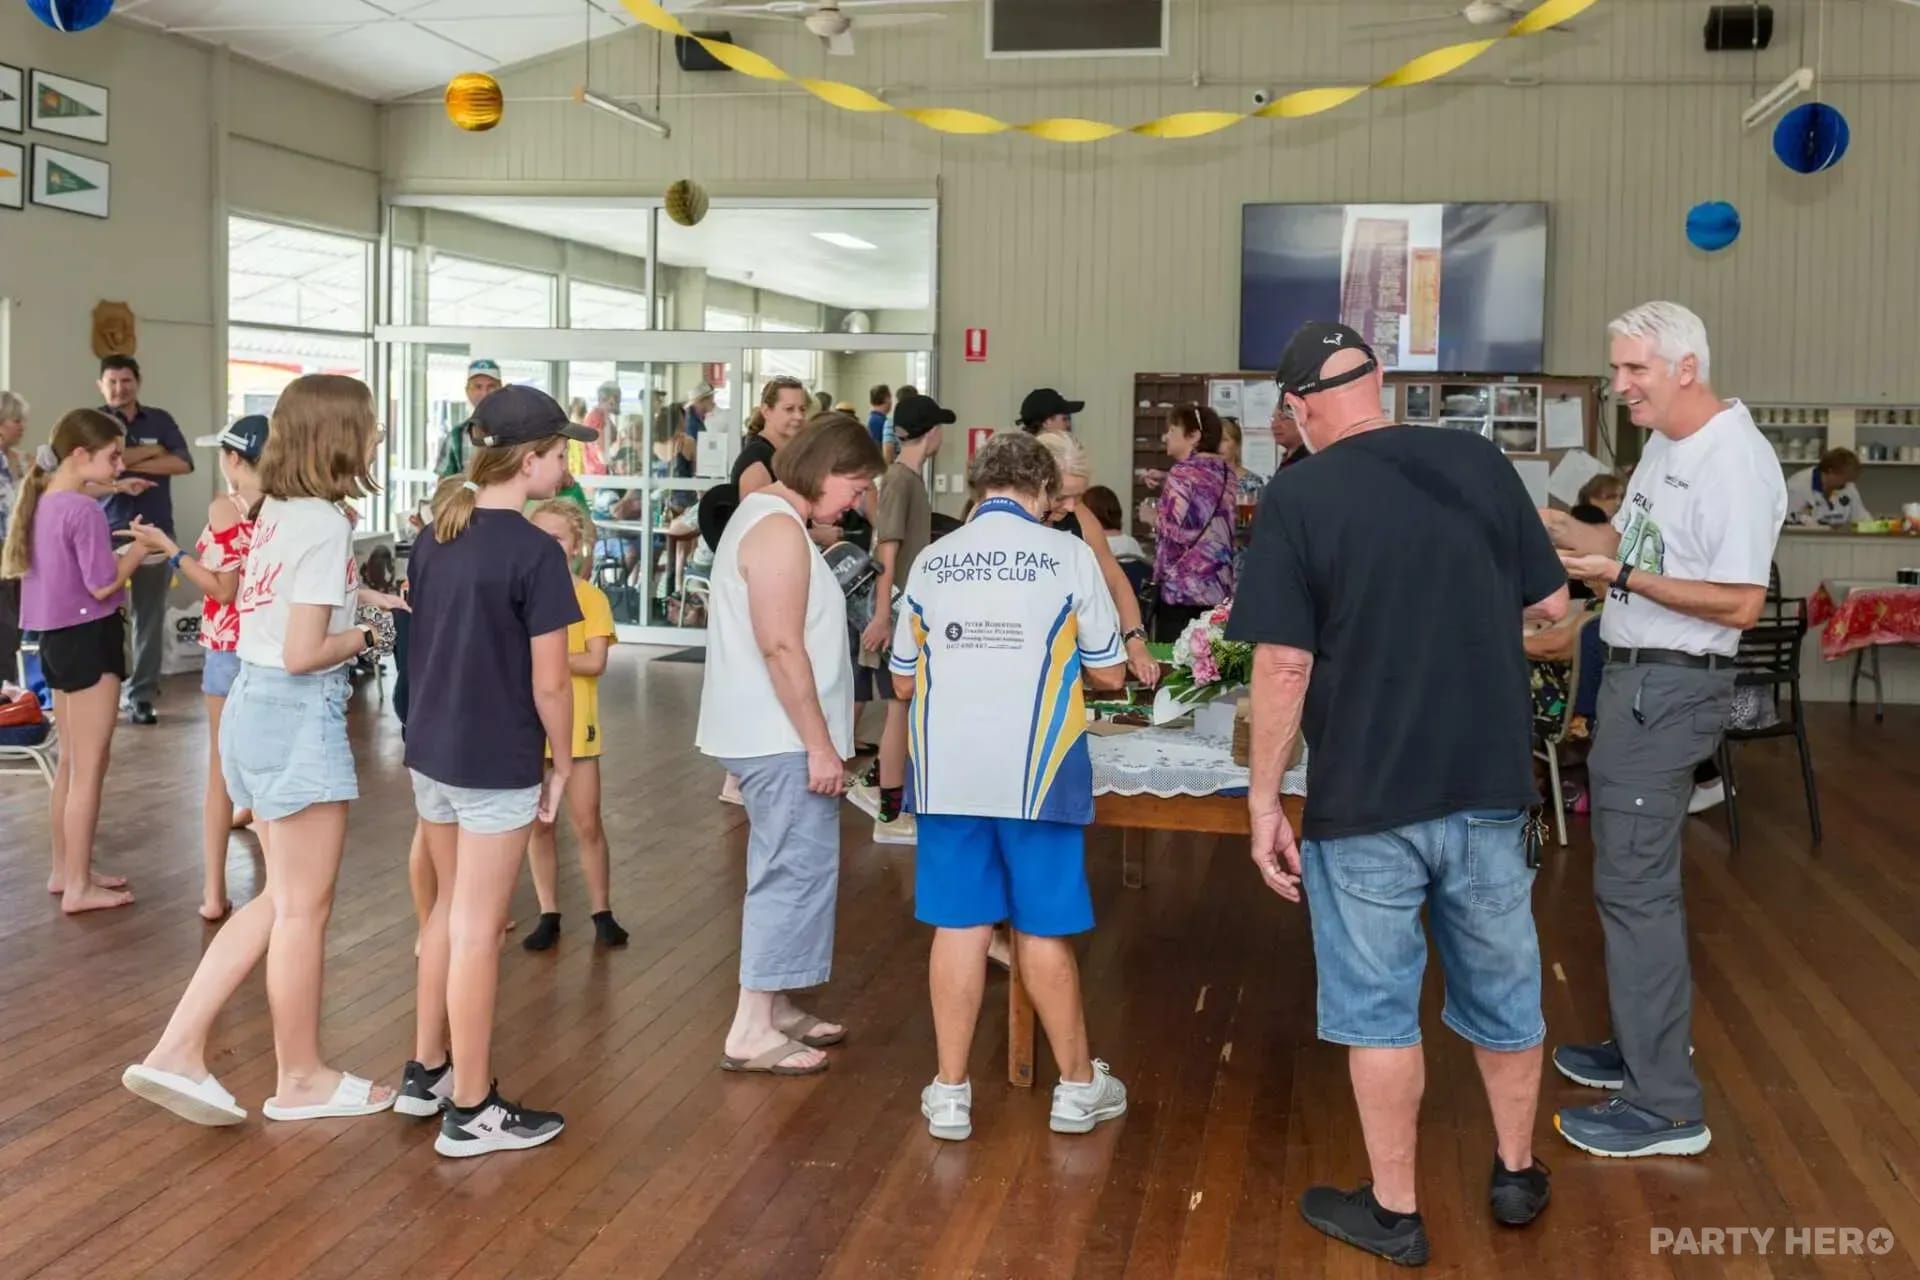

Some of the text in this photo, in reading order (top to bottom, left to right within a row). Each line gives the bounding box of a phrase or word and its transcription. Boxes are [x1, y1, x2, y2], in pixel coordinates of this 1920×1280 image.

[922, 551, 1060, 576] HOLLAND PARK
[936, 568, 1036, 584] SPORTS CLUB
[176, 616, 202, 633] QB
[478, 1123, 493, 1132] FILA
